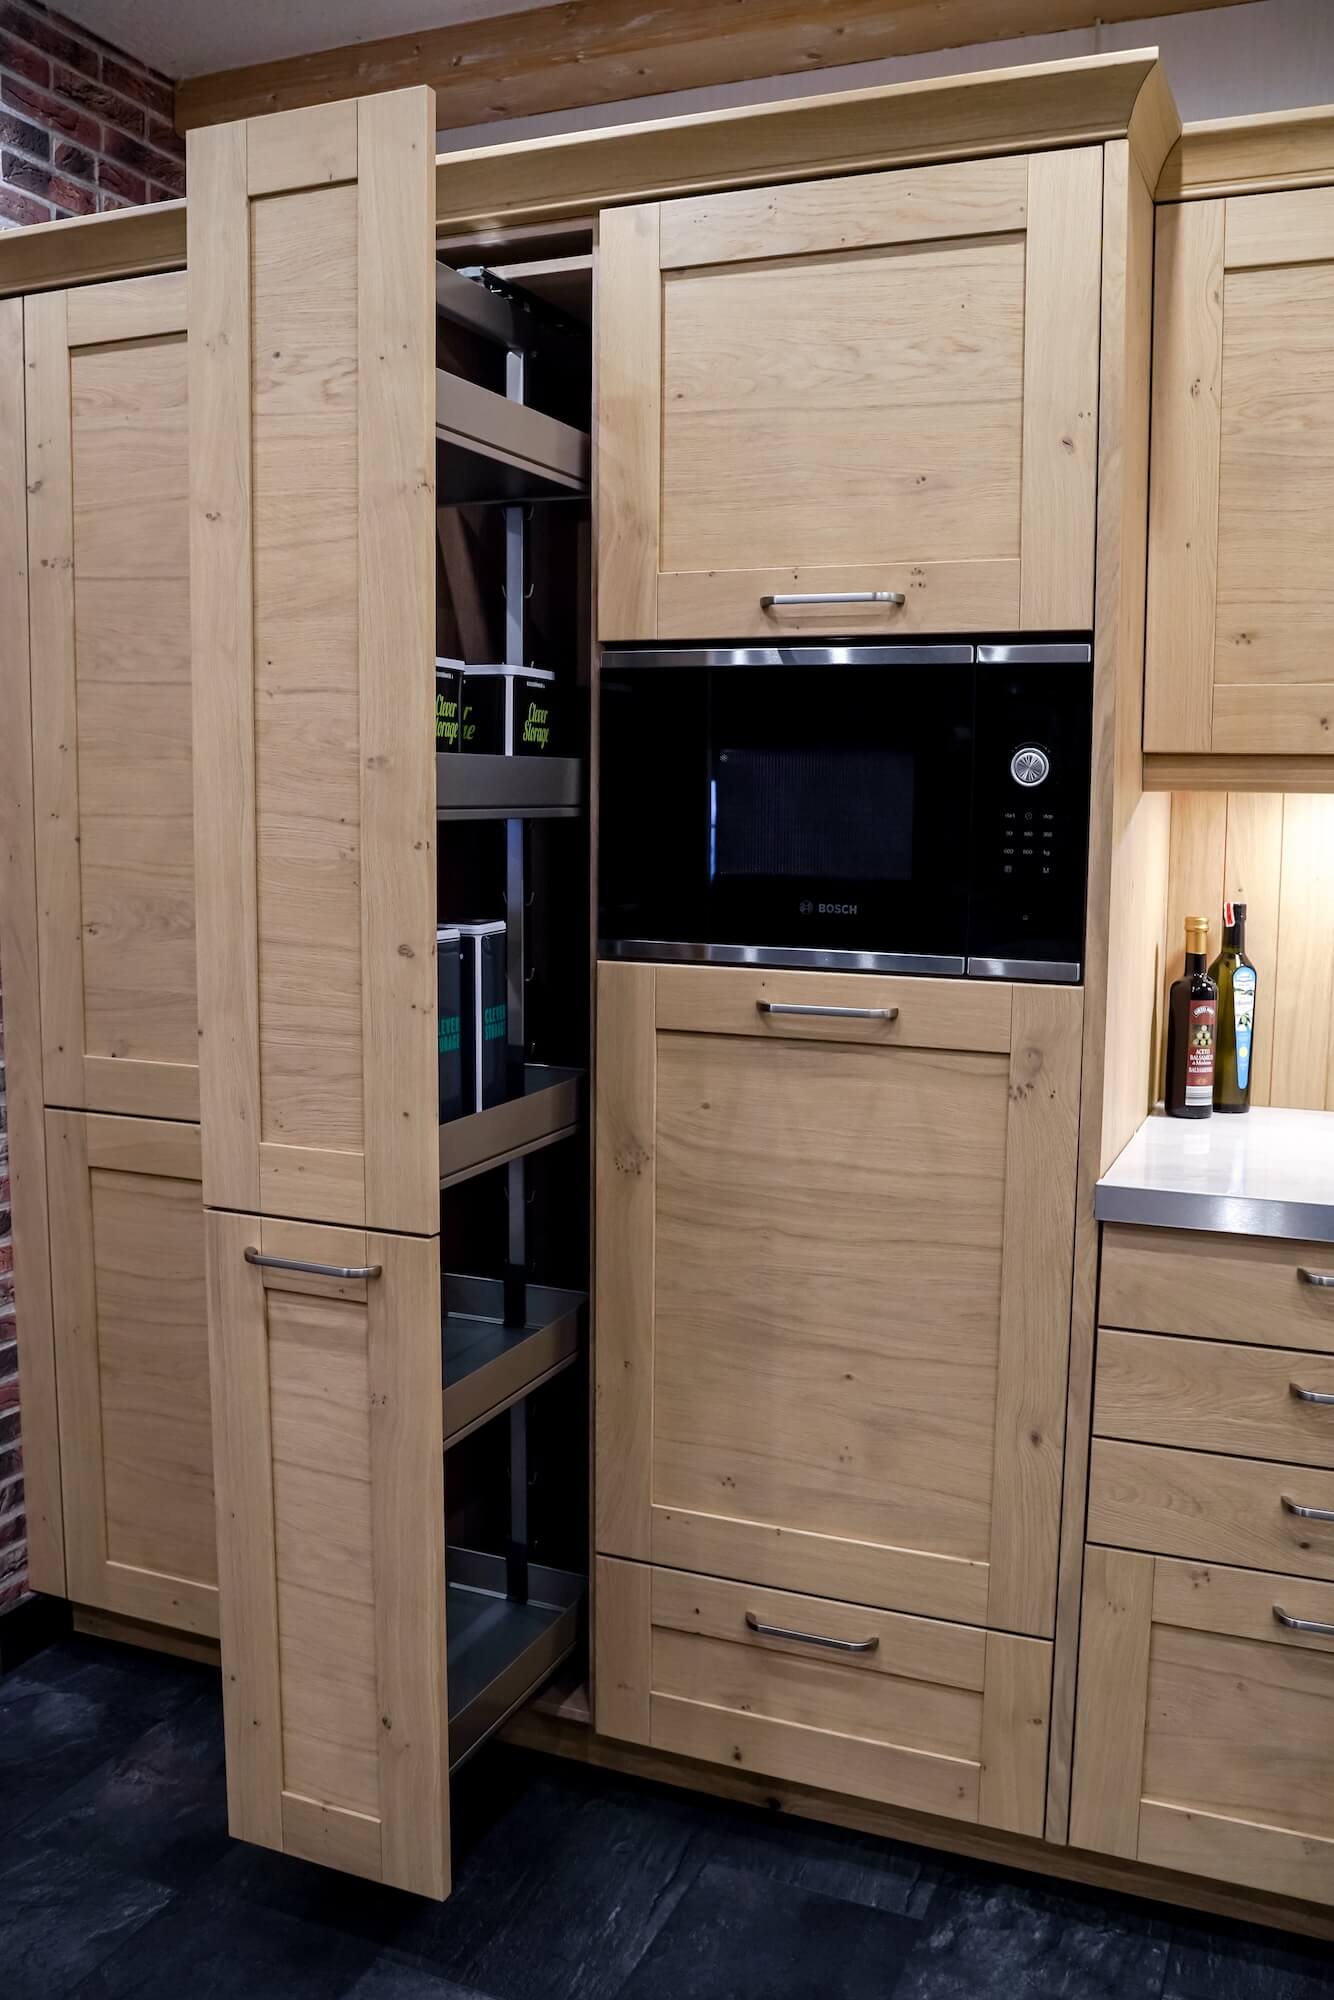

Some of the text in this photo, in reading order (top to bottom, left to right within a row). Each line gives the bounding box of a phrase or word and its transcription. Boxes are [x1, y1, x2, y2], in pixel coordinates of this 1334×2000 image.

[528, 701, 549, 724] Clever
[436, 716, 459, 745] torage
[522, 719, 550, 750] Storage
[818, 903, 858, 915] BOSCH
